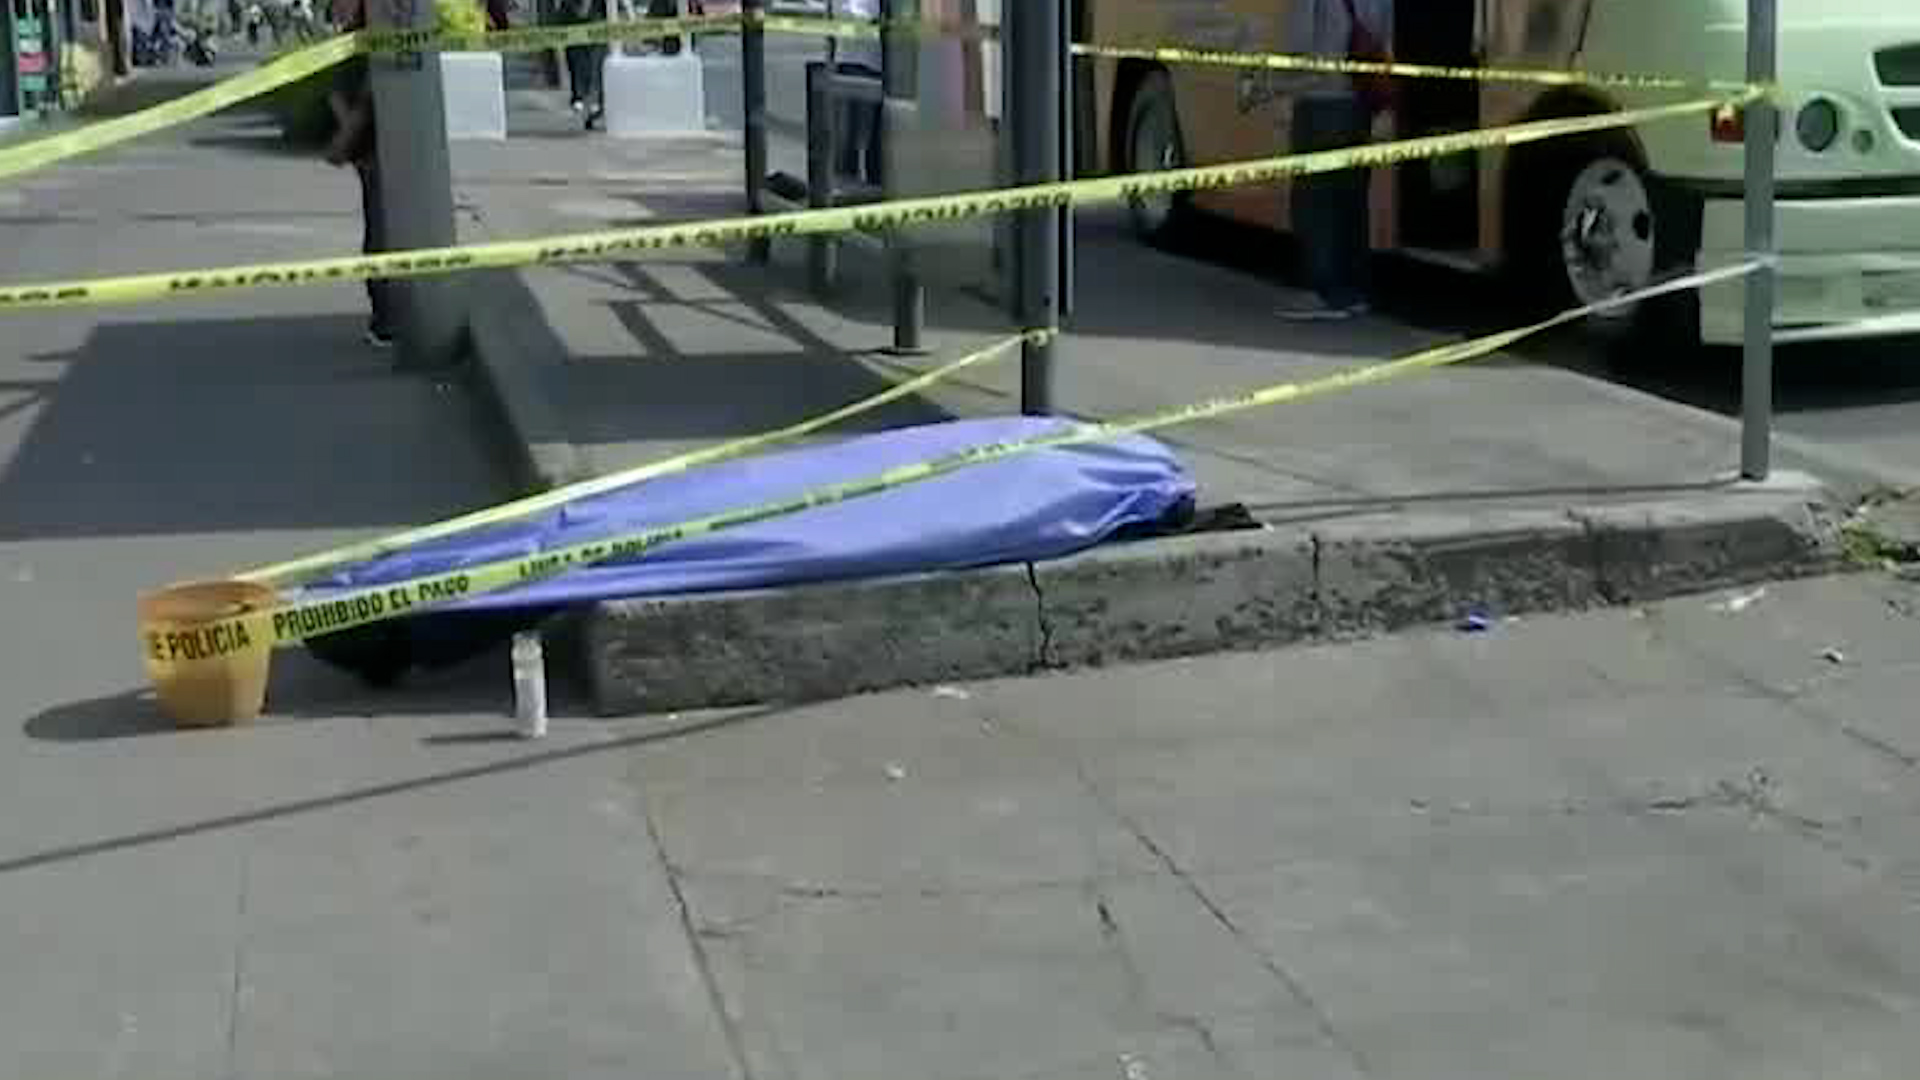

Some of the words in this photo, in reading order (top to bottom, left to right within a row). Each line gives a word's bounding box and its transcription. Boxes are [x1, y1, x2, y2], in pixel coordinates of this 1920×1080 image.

[167, 620, 250, 660] POLICIA
[273, 598, 382, 639] PROHIBIDO
[389, 588, 411, 610] EL
